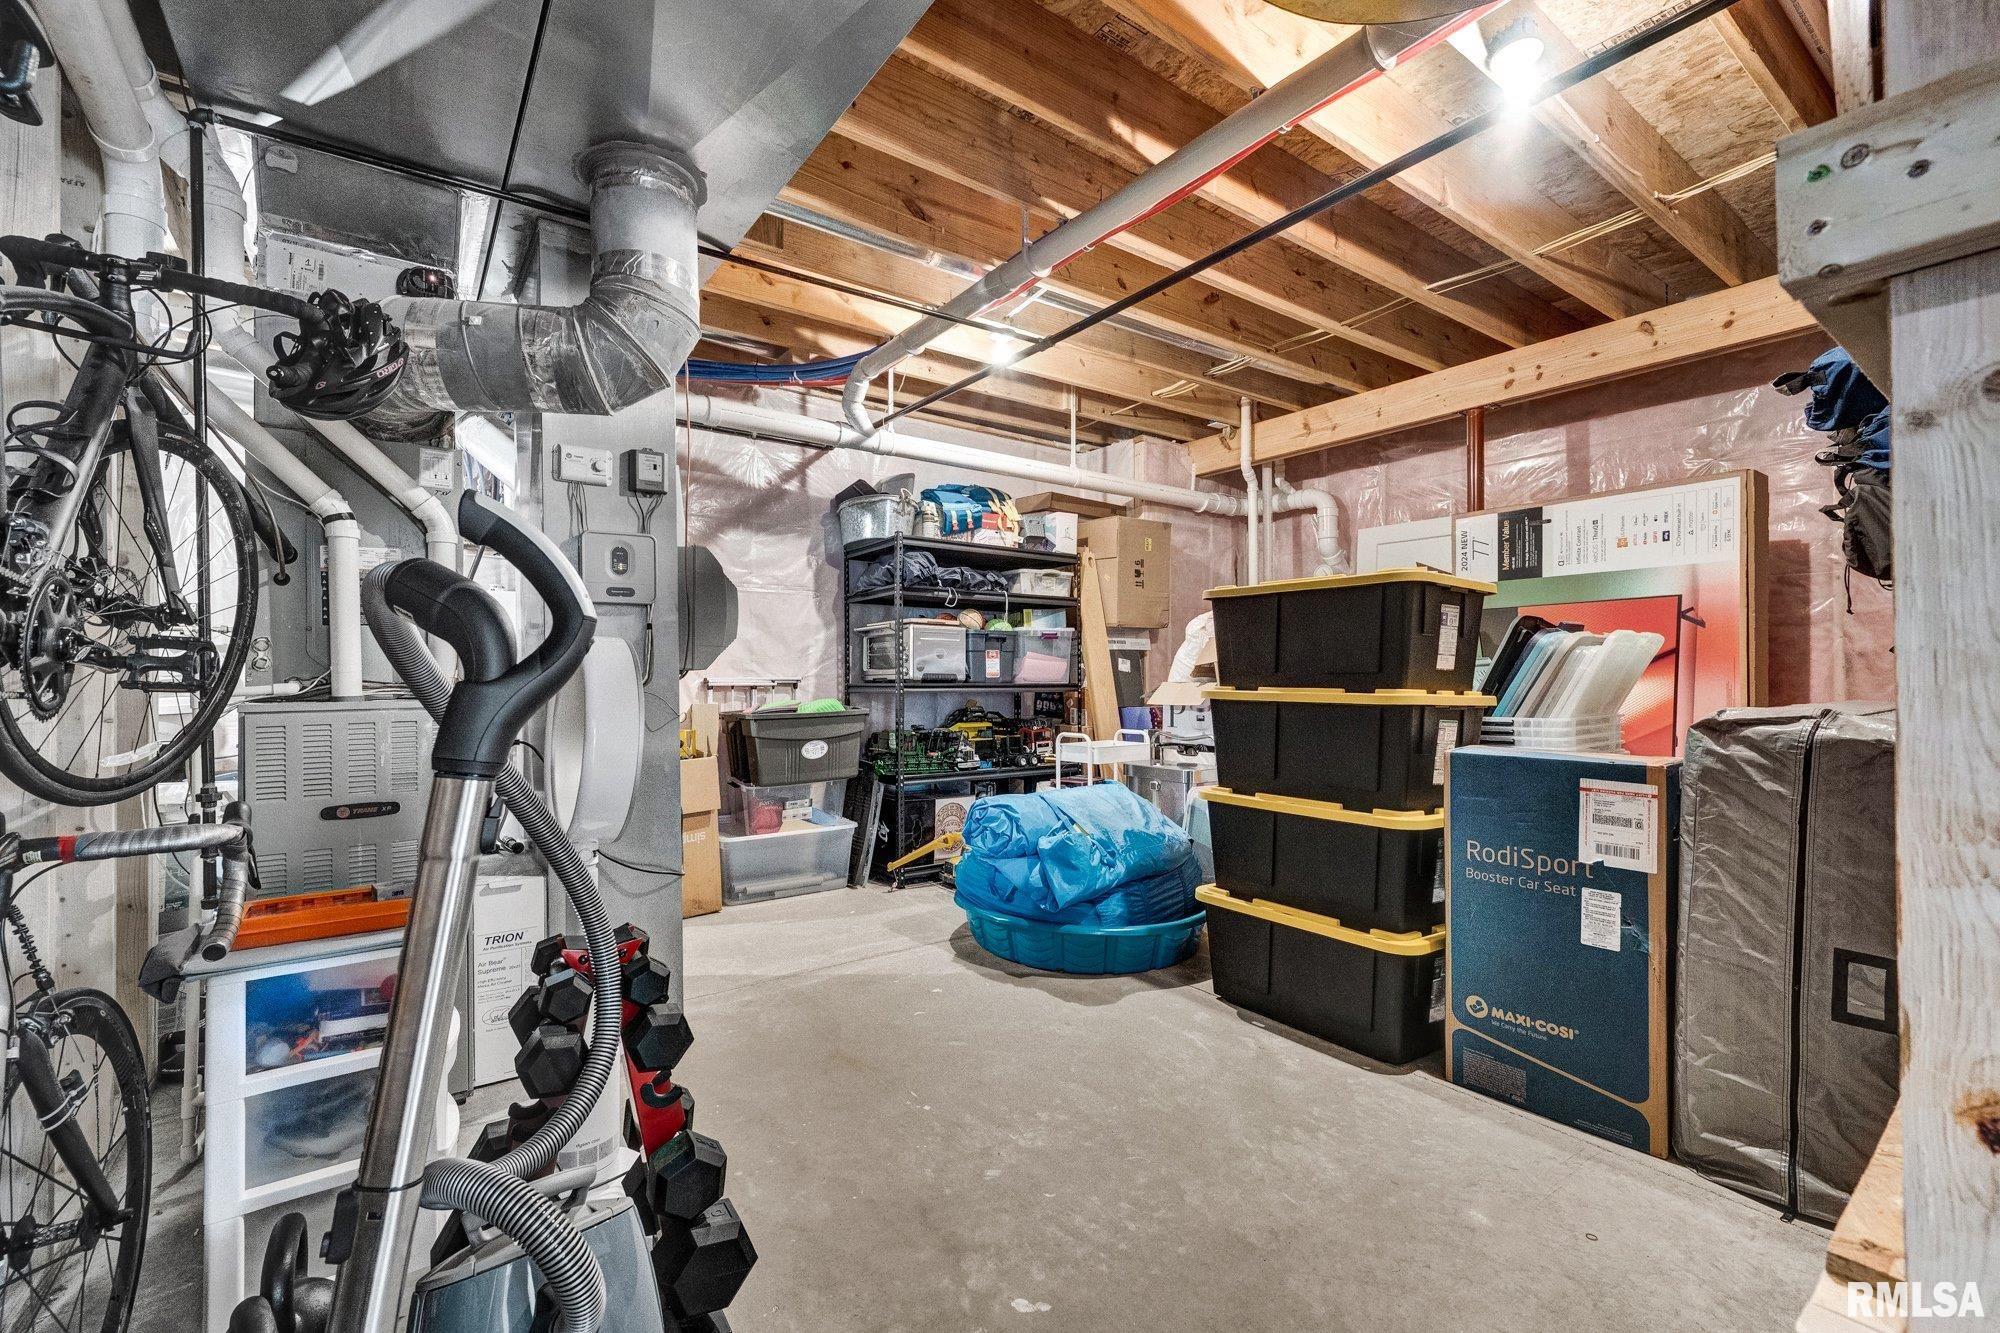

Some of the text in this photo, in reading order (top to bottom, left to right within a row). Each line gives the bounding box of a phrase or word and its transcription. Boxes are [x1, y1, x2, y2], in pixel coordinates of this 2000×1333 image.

[1501, 519, 1510, 571] Member Value
[1466, 839, 1594, 879] RodiSport
[1465, 867, 1577, 897] Booster Car Seat
[484, 931, 524, 946] TRION
